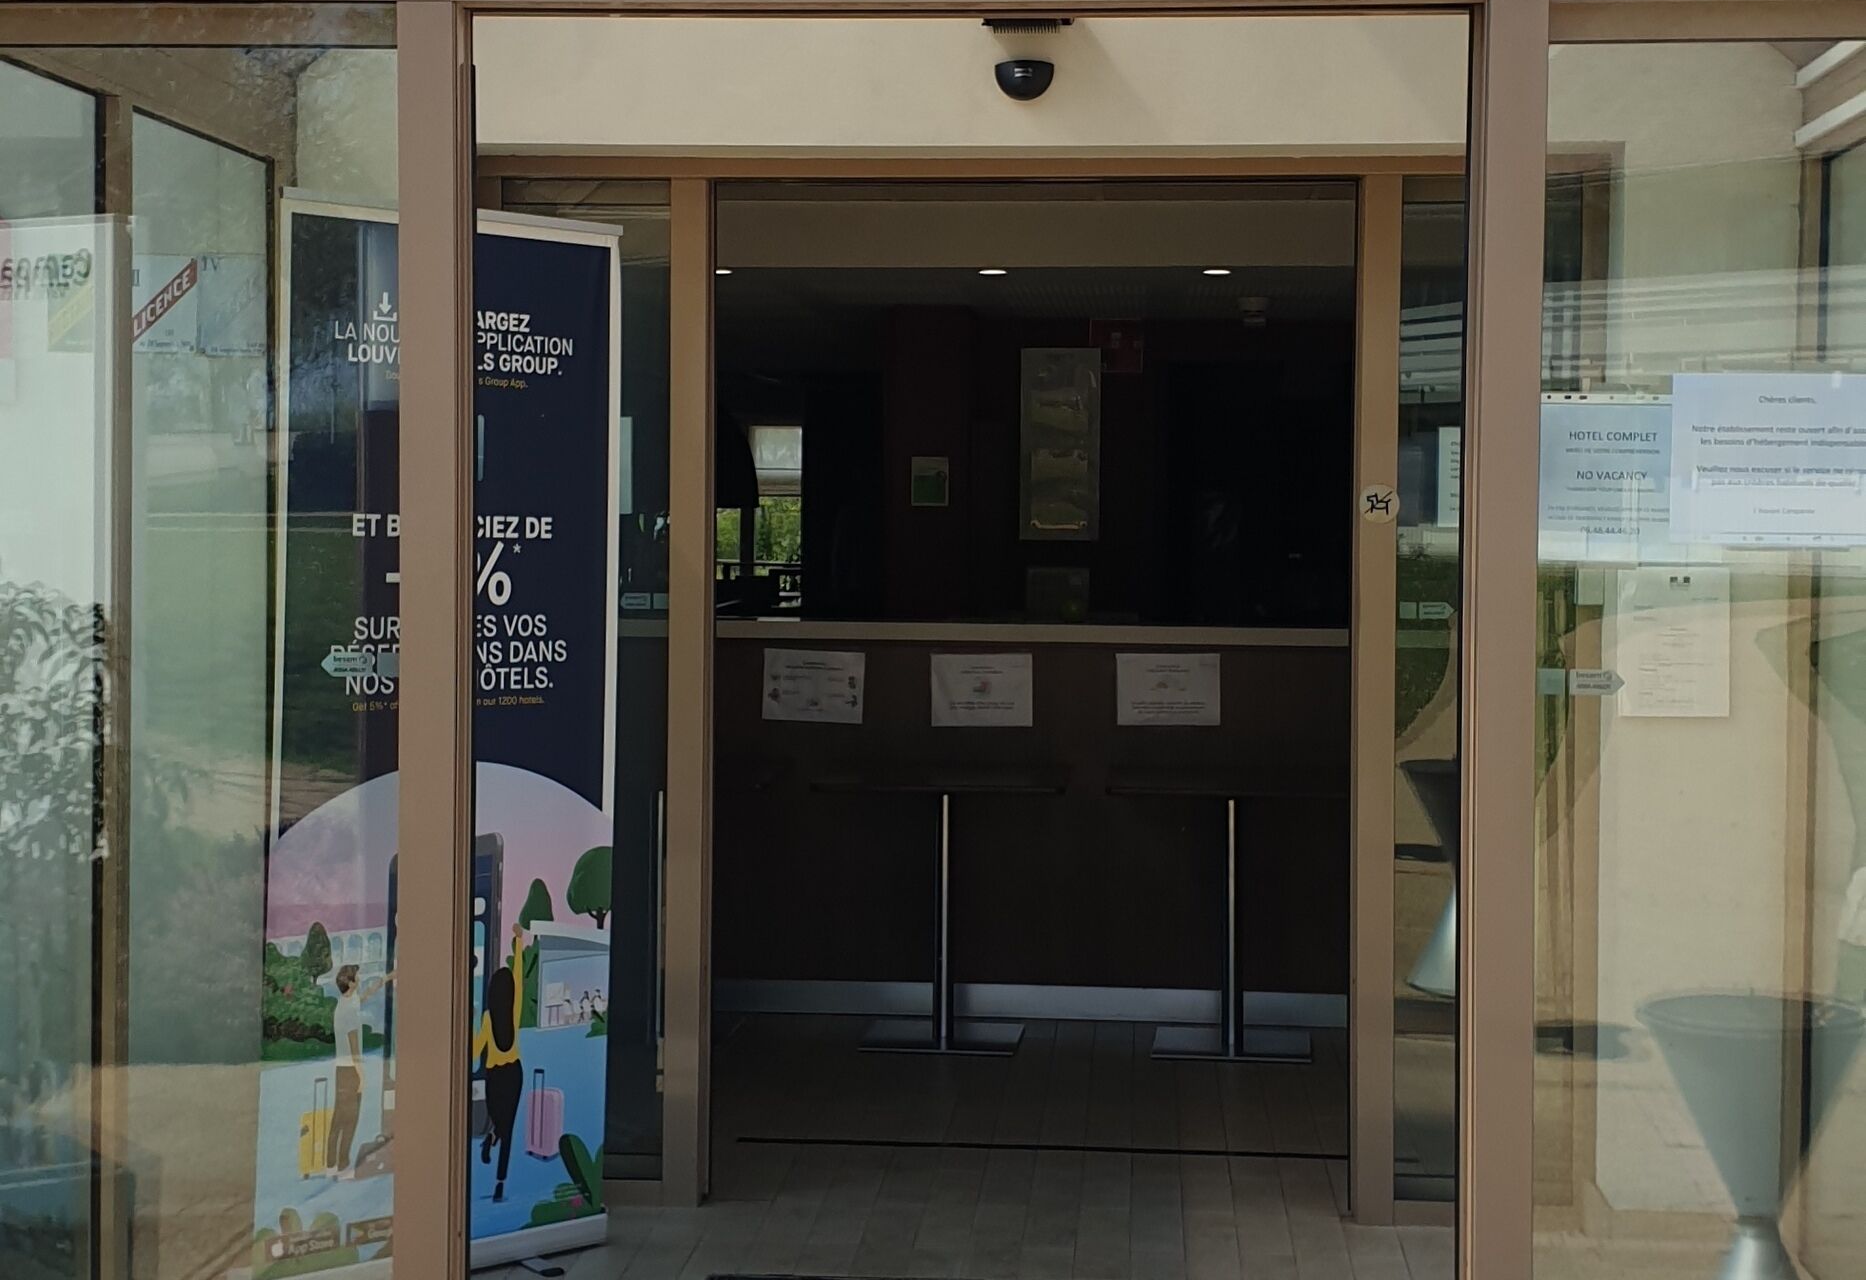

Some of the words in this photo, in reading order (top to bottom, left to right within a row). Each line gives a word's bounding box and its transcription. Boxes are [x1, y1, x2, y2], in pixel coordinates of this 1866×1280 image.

[134, 268, 190, 337] LICENCE
[477, 310, 530, 333] ARGEZ
[335, 320, 357, 340] LA
[363, 322, 400, 342] NOU
[477, 331, 573, 356] PPLICATION
[348, 343, 400, 364] LOUV
[499, 353, 562, 376] GROUP.
[1569, 430, 1604, 441] HOTEL
[1606, 431, 1658, 442] COMPLET
[1576, 470, 1594, 480] NO
[1596, 470, 1649, 481] VACANCY
[352, 513, 381, 537] ET
[525, 516, 553, 539] DE
[503, 614, 547, 637] VOS
[509, 639, 567, 663] DANS
[477, 663, 554, 690] ÔTELS.
